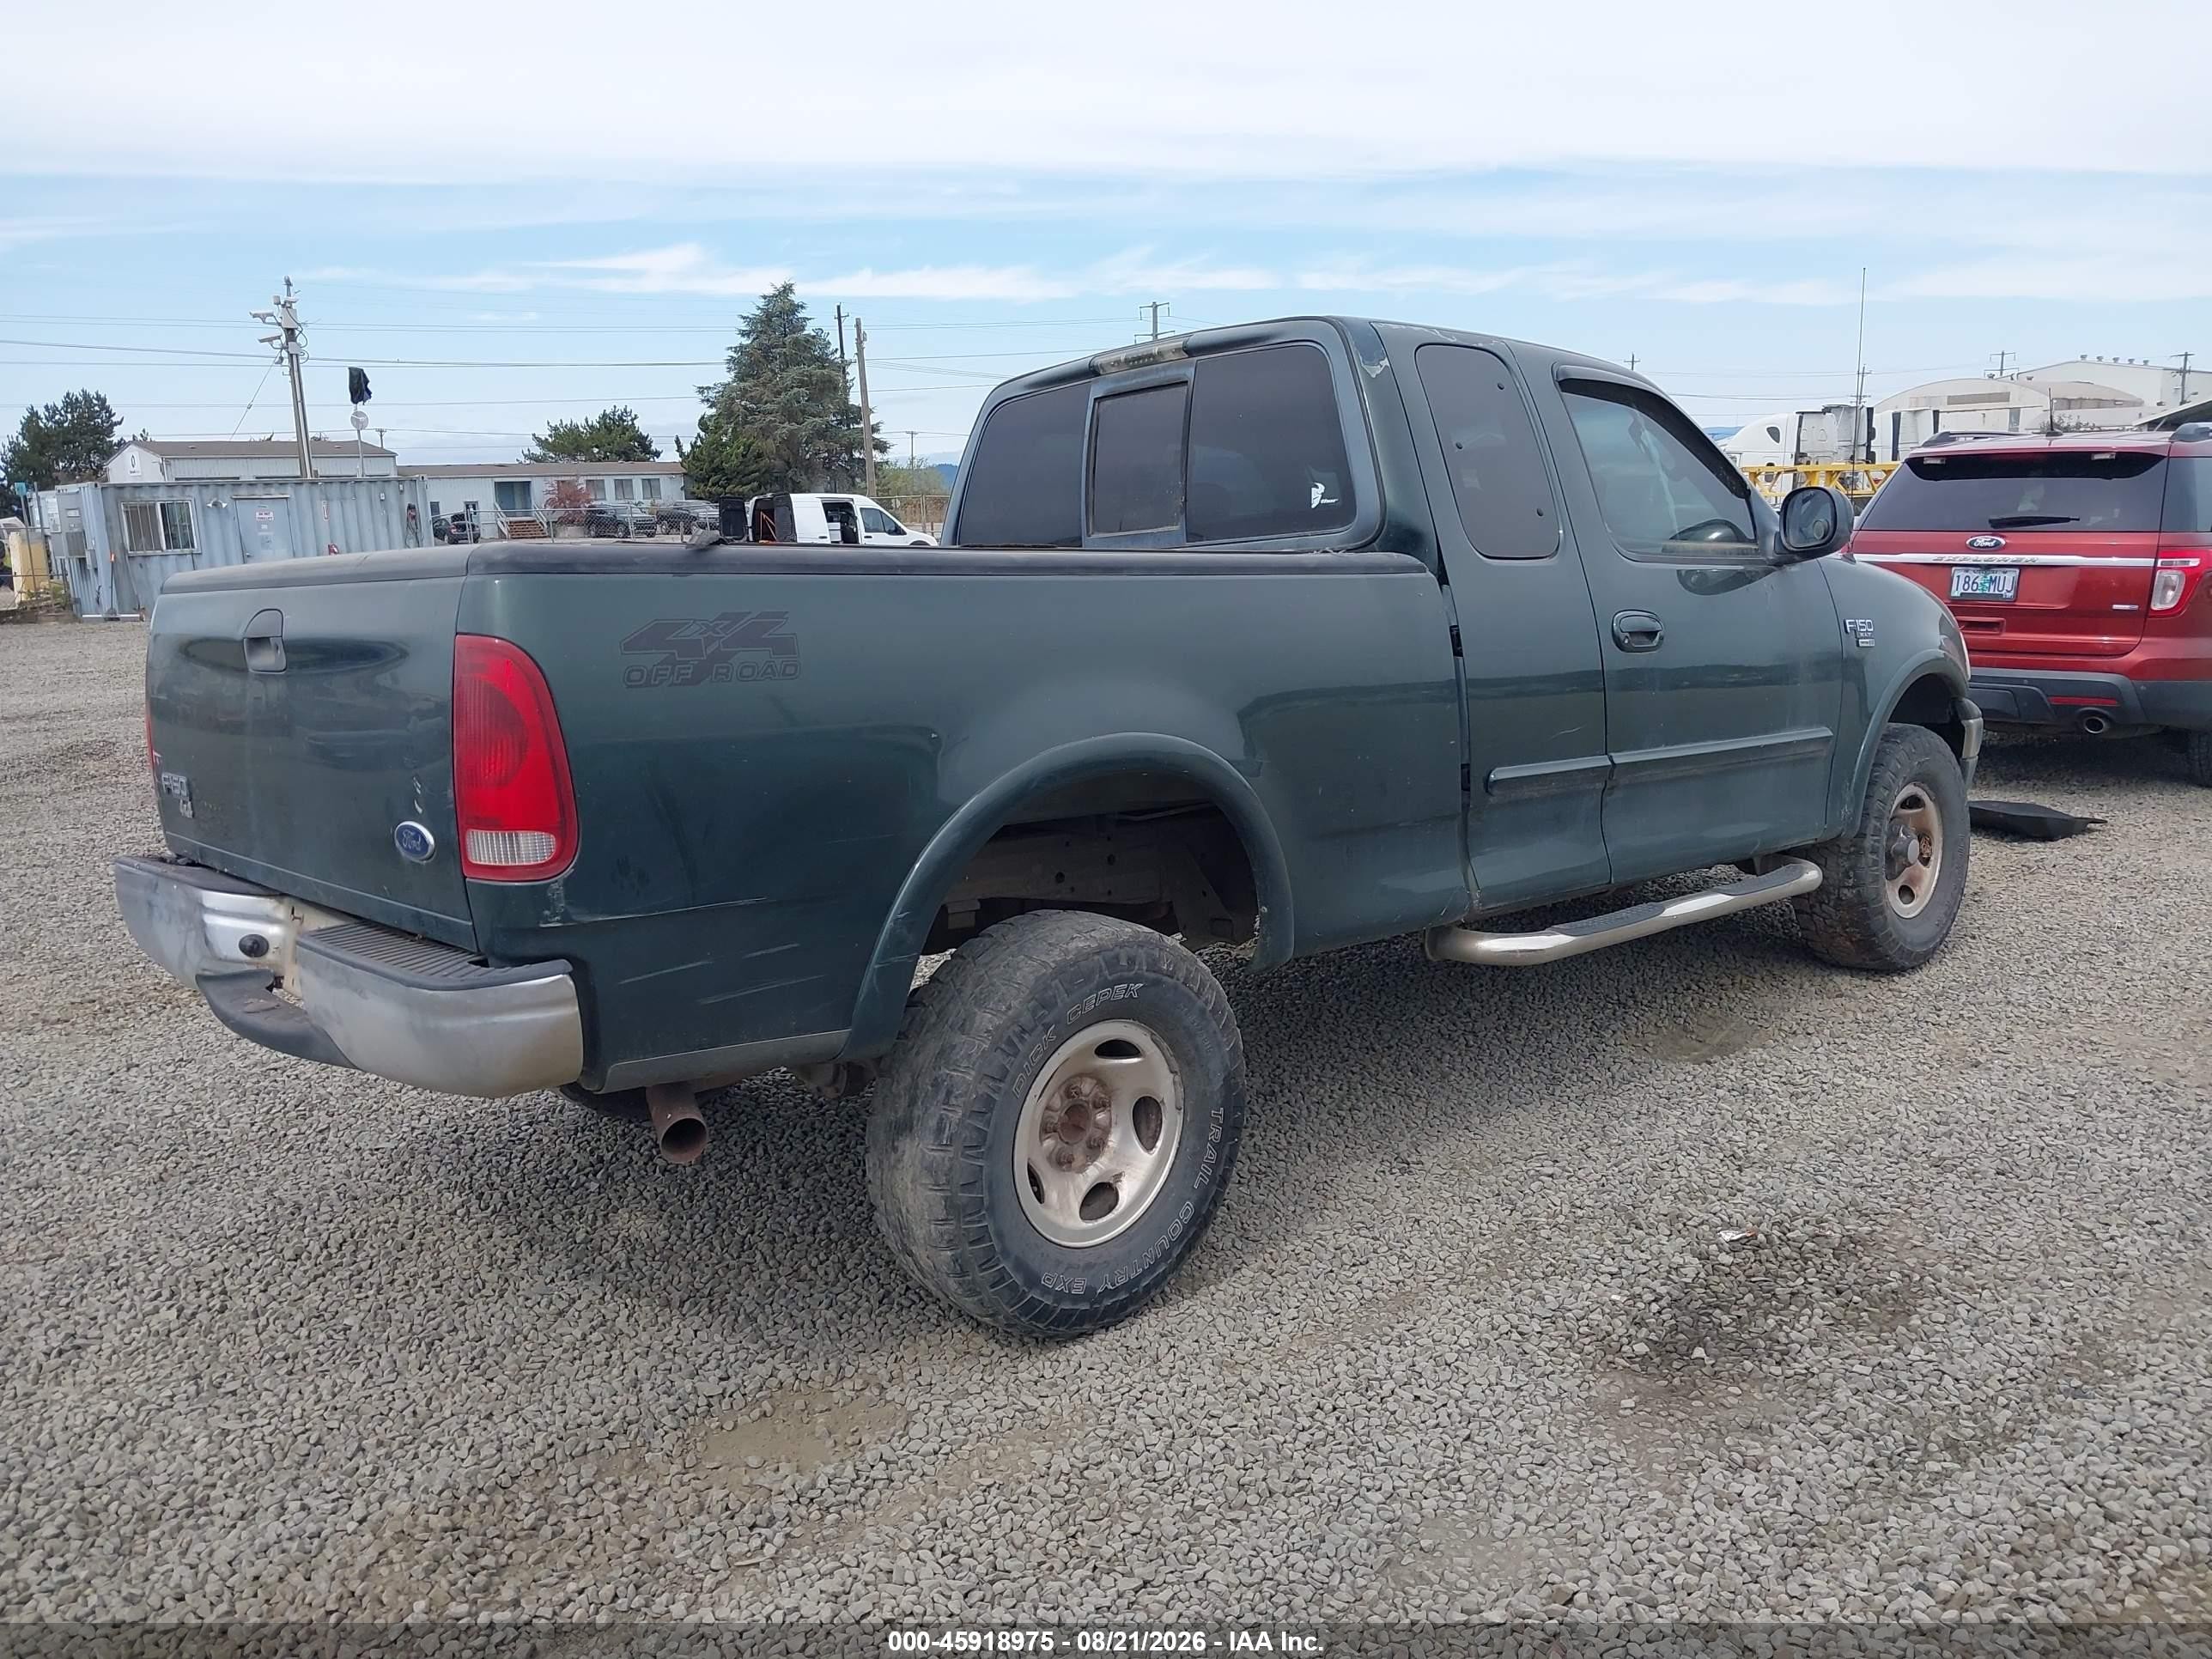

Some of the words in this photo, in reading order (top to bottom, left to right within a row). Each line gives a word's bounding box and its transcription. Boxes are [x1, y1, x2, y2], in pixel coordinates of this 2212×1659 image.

[1955, 574, 1978, 592] 186
[1988, 574, 2015, 592] MUJ
[1844, 618, 1874, 634] F150
[623, 662, 696, 687] OFF
[711, 659, 800, 683] ROAD
[1012, 1024, 1056, 1099] DICK
[1066, 983, 1144, 1024] CEPEK
[1193, 1107, 1224, 1190] TRAIL
[1097, 1200, 1194, 1297] COUNTRY
[1041, 1271, 1087, 1295] EXP
